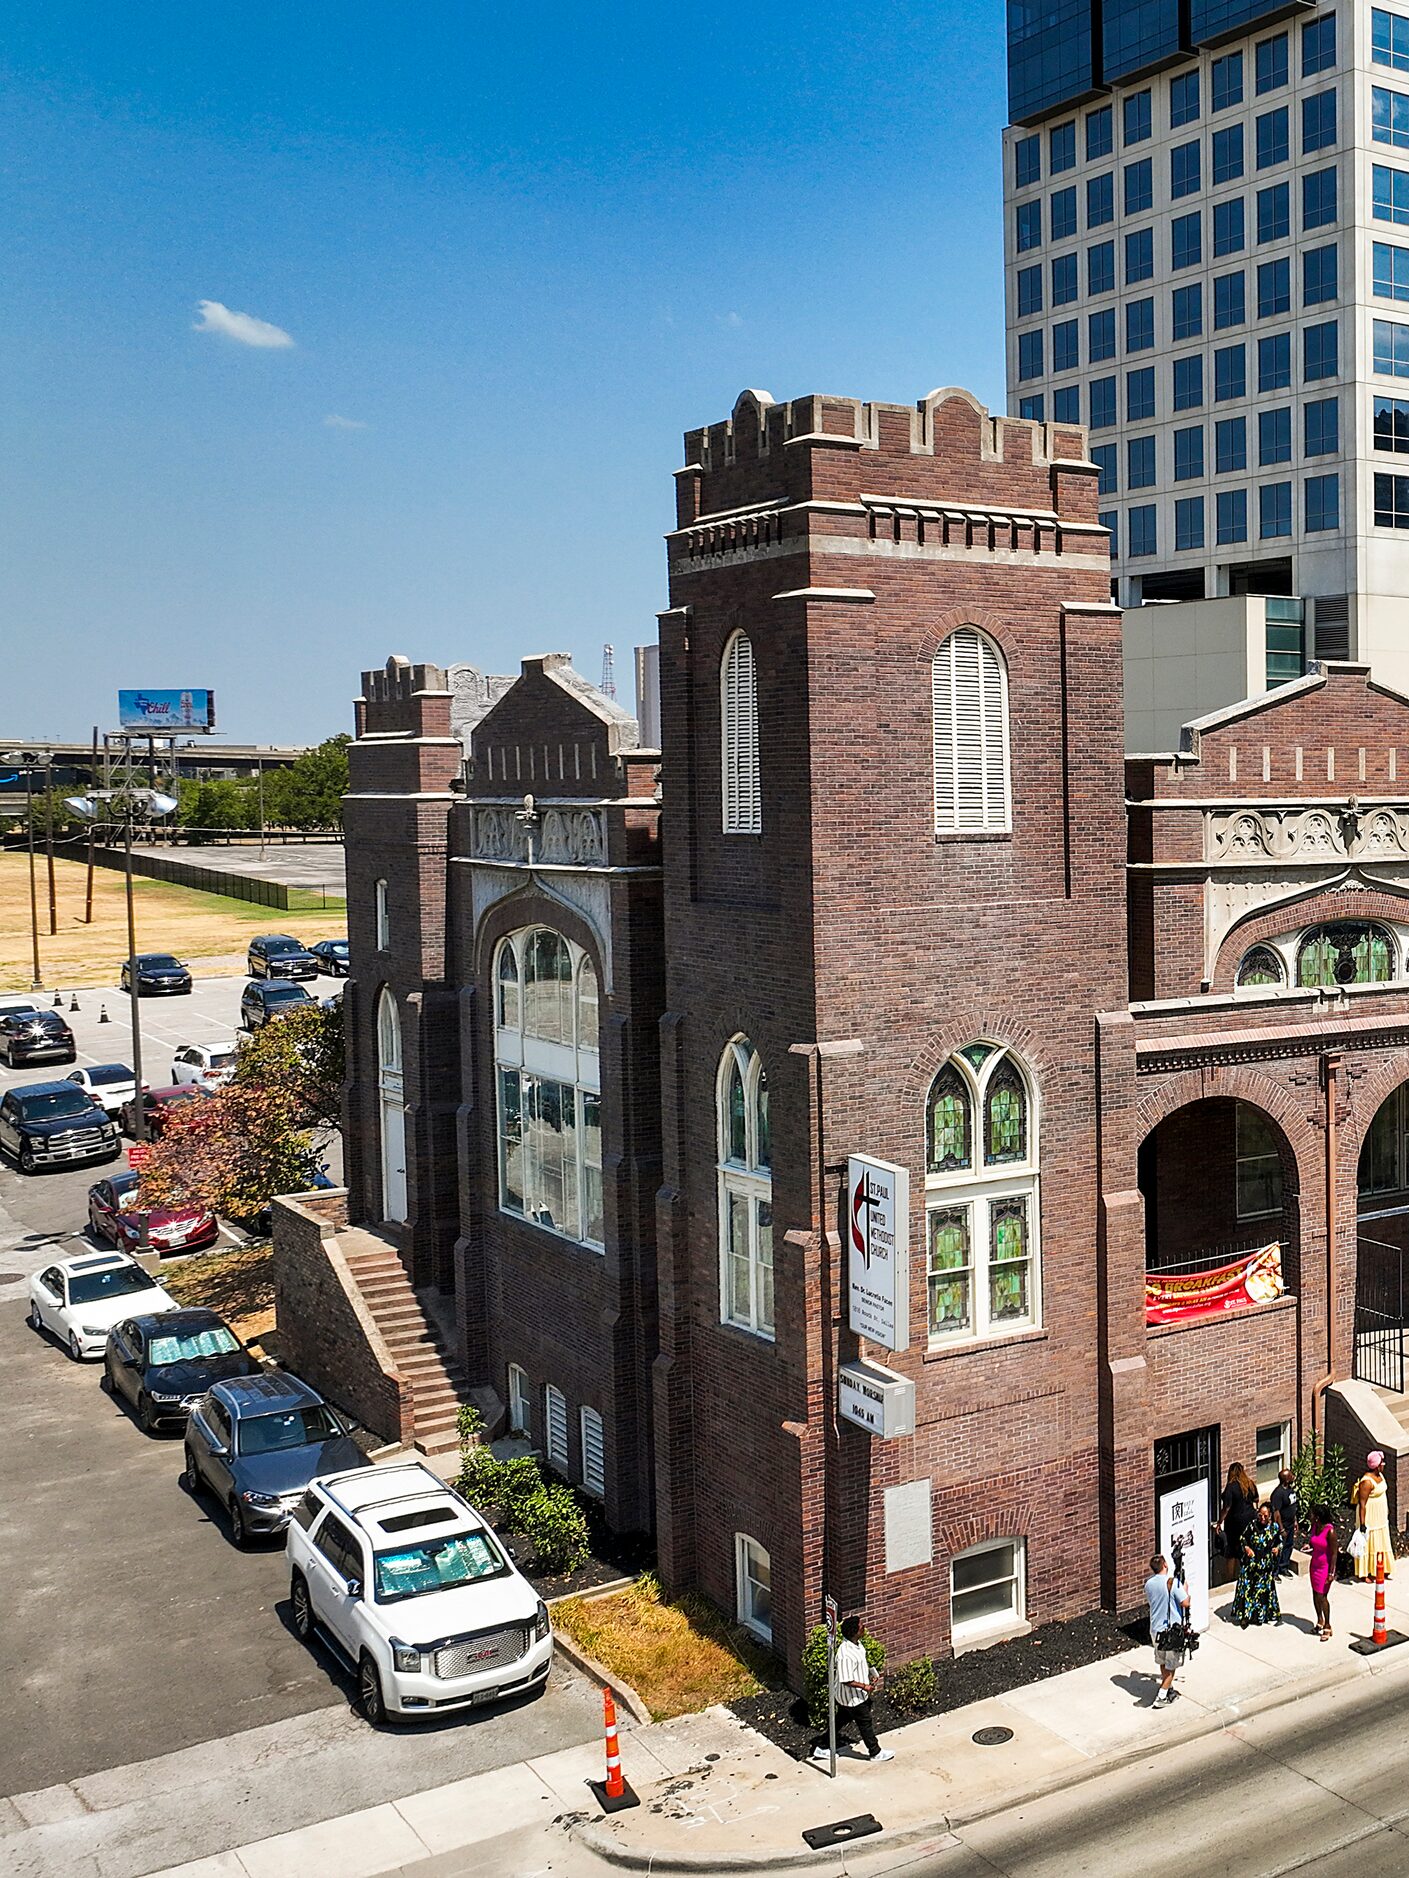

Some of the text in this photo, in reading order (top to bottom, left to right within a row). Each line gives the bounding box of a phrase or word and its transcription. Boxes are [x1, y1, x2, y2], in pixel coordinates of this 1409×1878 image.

[147, 701, 170, 713] Chill
[870, 1210, 887, 1227] UNITED
[870, 1226, 895, 1246] METHODIST
[870, 1243, 889, 1261] CHURCH
[1165, 1266, 1244, 1292] BREAKFAST
[840, 1374, 884, 1404] SUNDAY WORSHIP
[866, 1412, 875, 1425] AM
